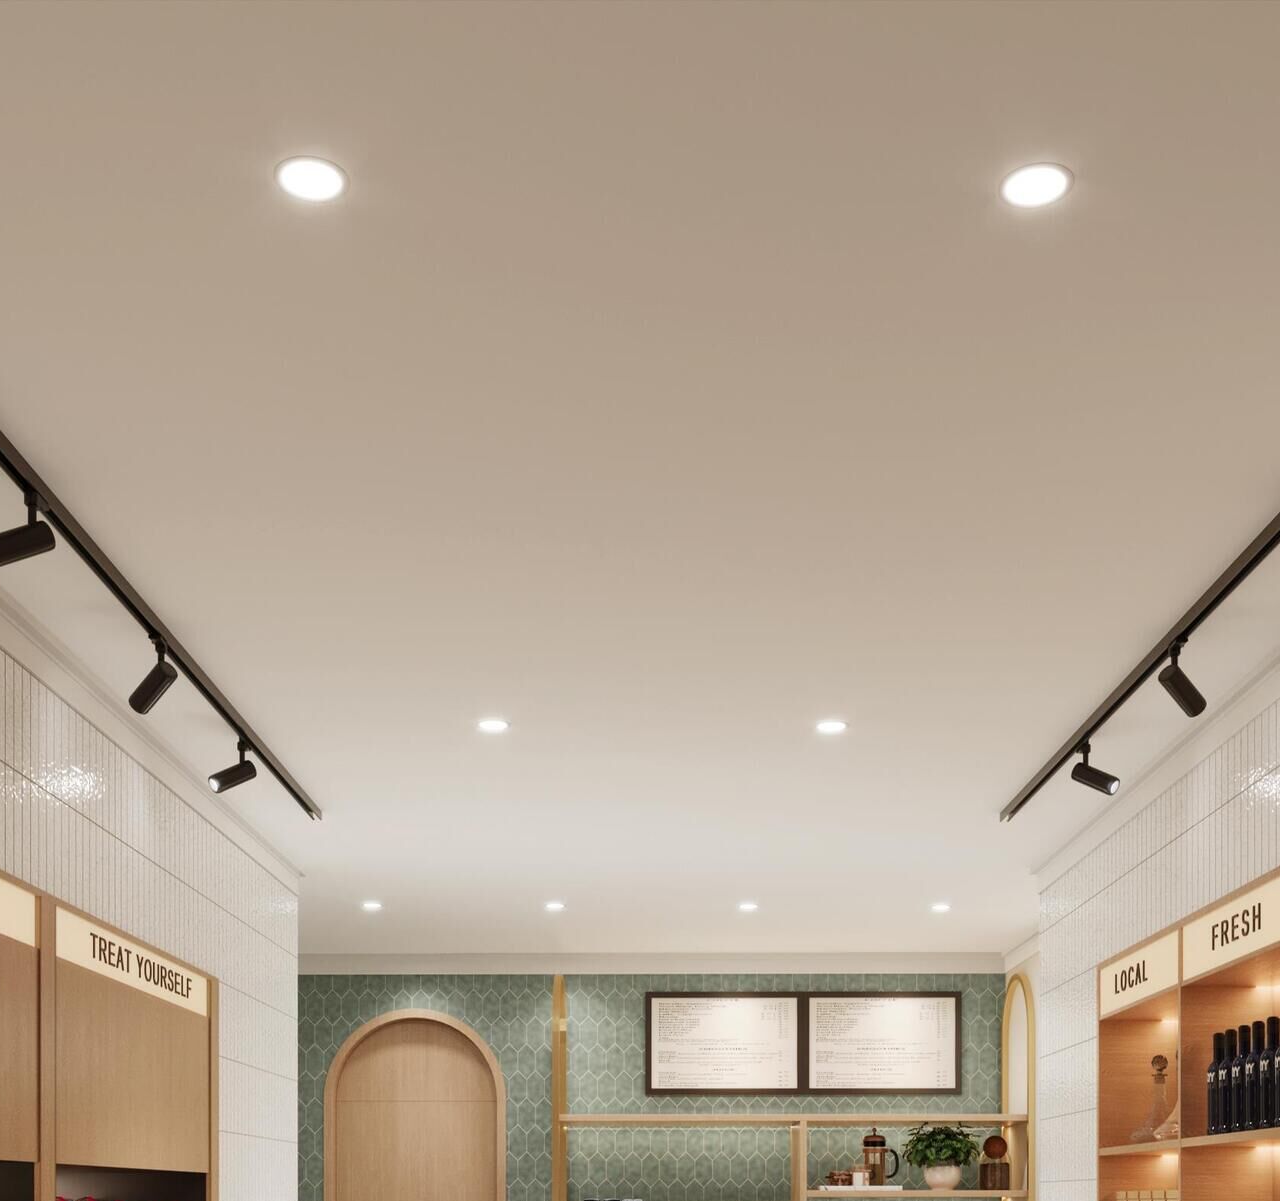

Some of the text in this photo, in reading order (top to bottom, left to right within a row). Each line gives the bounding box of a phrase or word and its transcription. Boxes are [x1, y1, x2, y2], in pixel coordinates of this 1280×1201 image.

[1211, 902, 1262, 951] FRESH
[90, 932, 192, 999] TREAT YOURSELF
[1114, 960, 1148, 994] LOCAL
